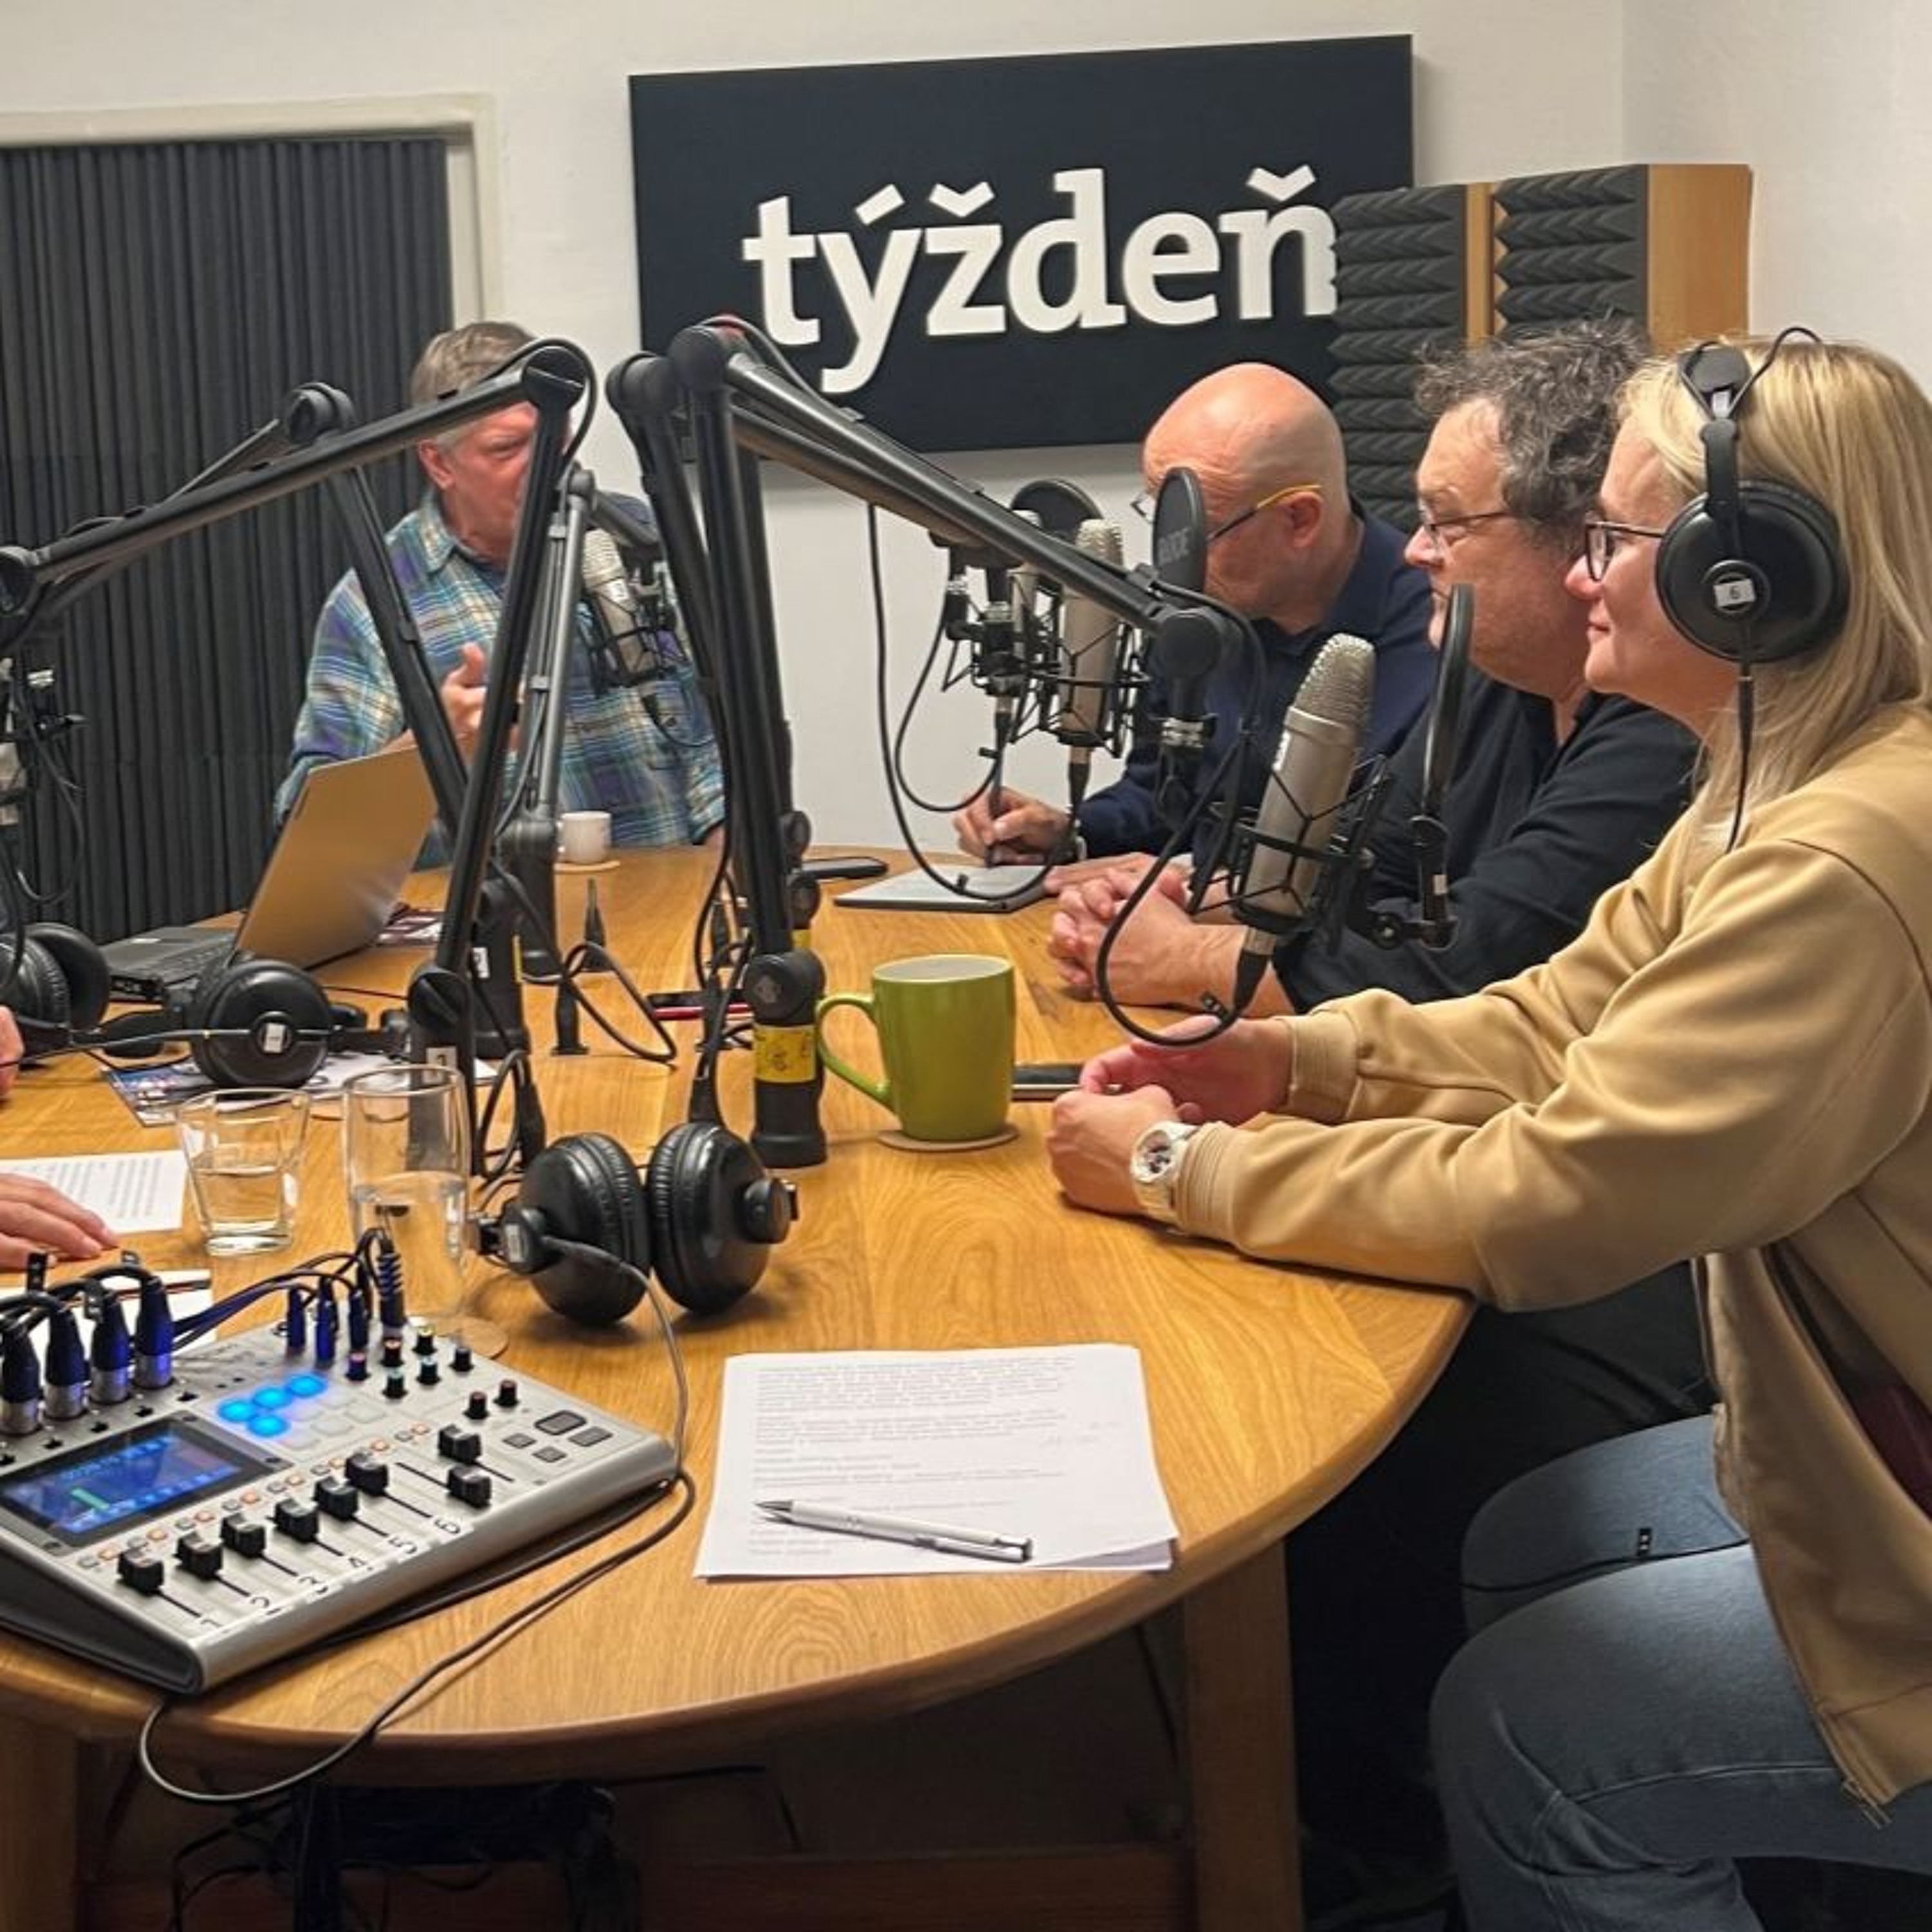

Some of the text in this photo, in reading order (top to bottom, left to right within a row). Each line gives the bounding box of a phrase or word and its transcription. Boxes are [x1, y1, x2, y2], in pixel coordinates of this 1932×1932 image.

[743, 165, 1338, 393] týždeň
[250, 1596, 281, 1615] 2
[298, 1577, 329, 1595] 3
[348, 1557, 374, 1571] 4
[388, 1537, 418, 1555] 5
[434, 1519, 461, 1535] 6
